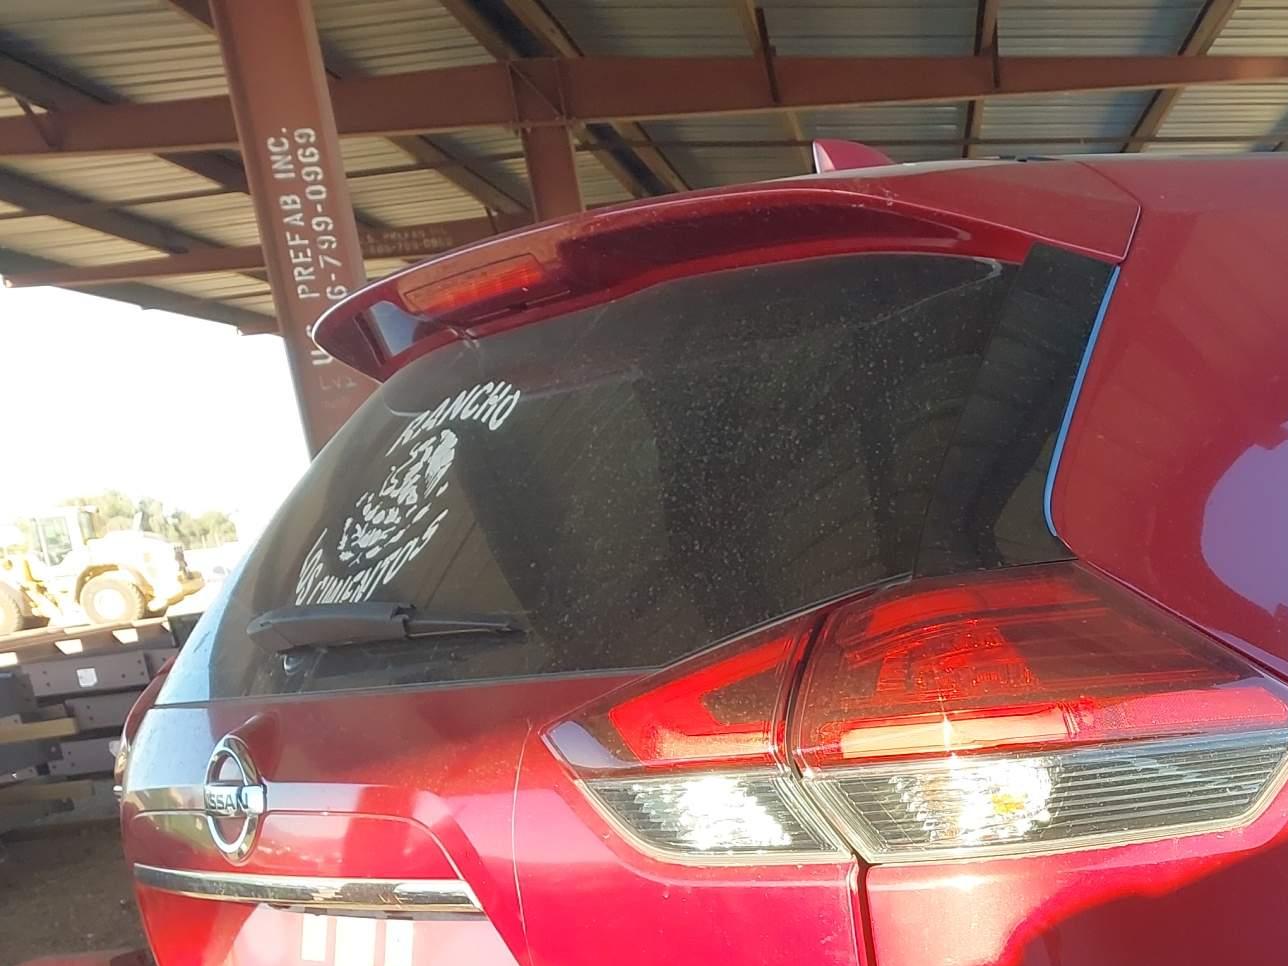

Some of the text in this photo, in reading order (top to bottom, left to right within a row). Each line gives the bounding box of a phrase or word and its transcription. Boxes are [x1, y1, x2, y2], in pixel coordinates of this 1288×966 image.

[267, 127, 296, 179] INC.
[279, 194, 320, 299] PREFAB
[385, 381, 521, 457] RANCHO
